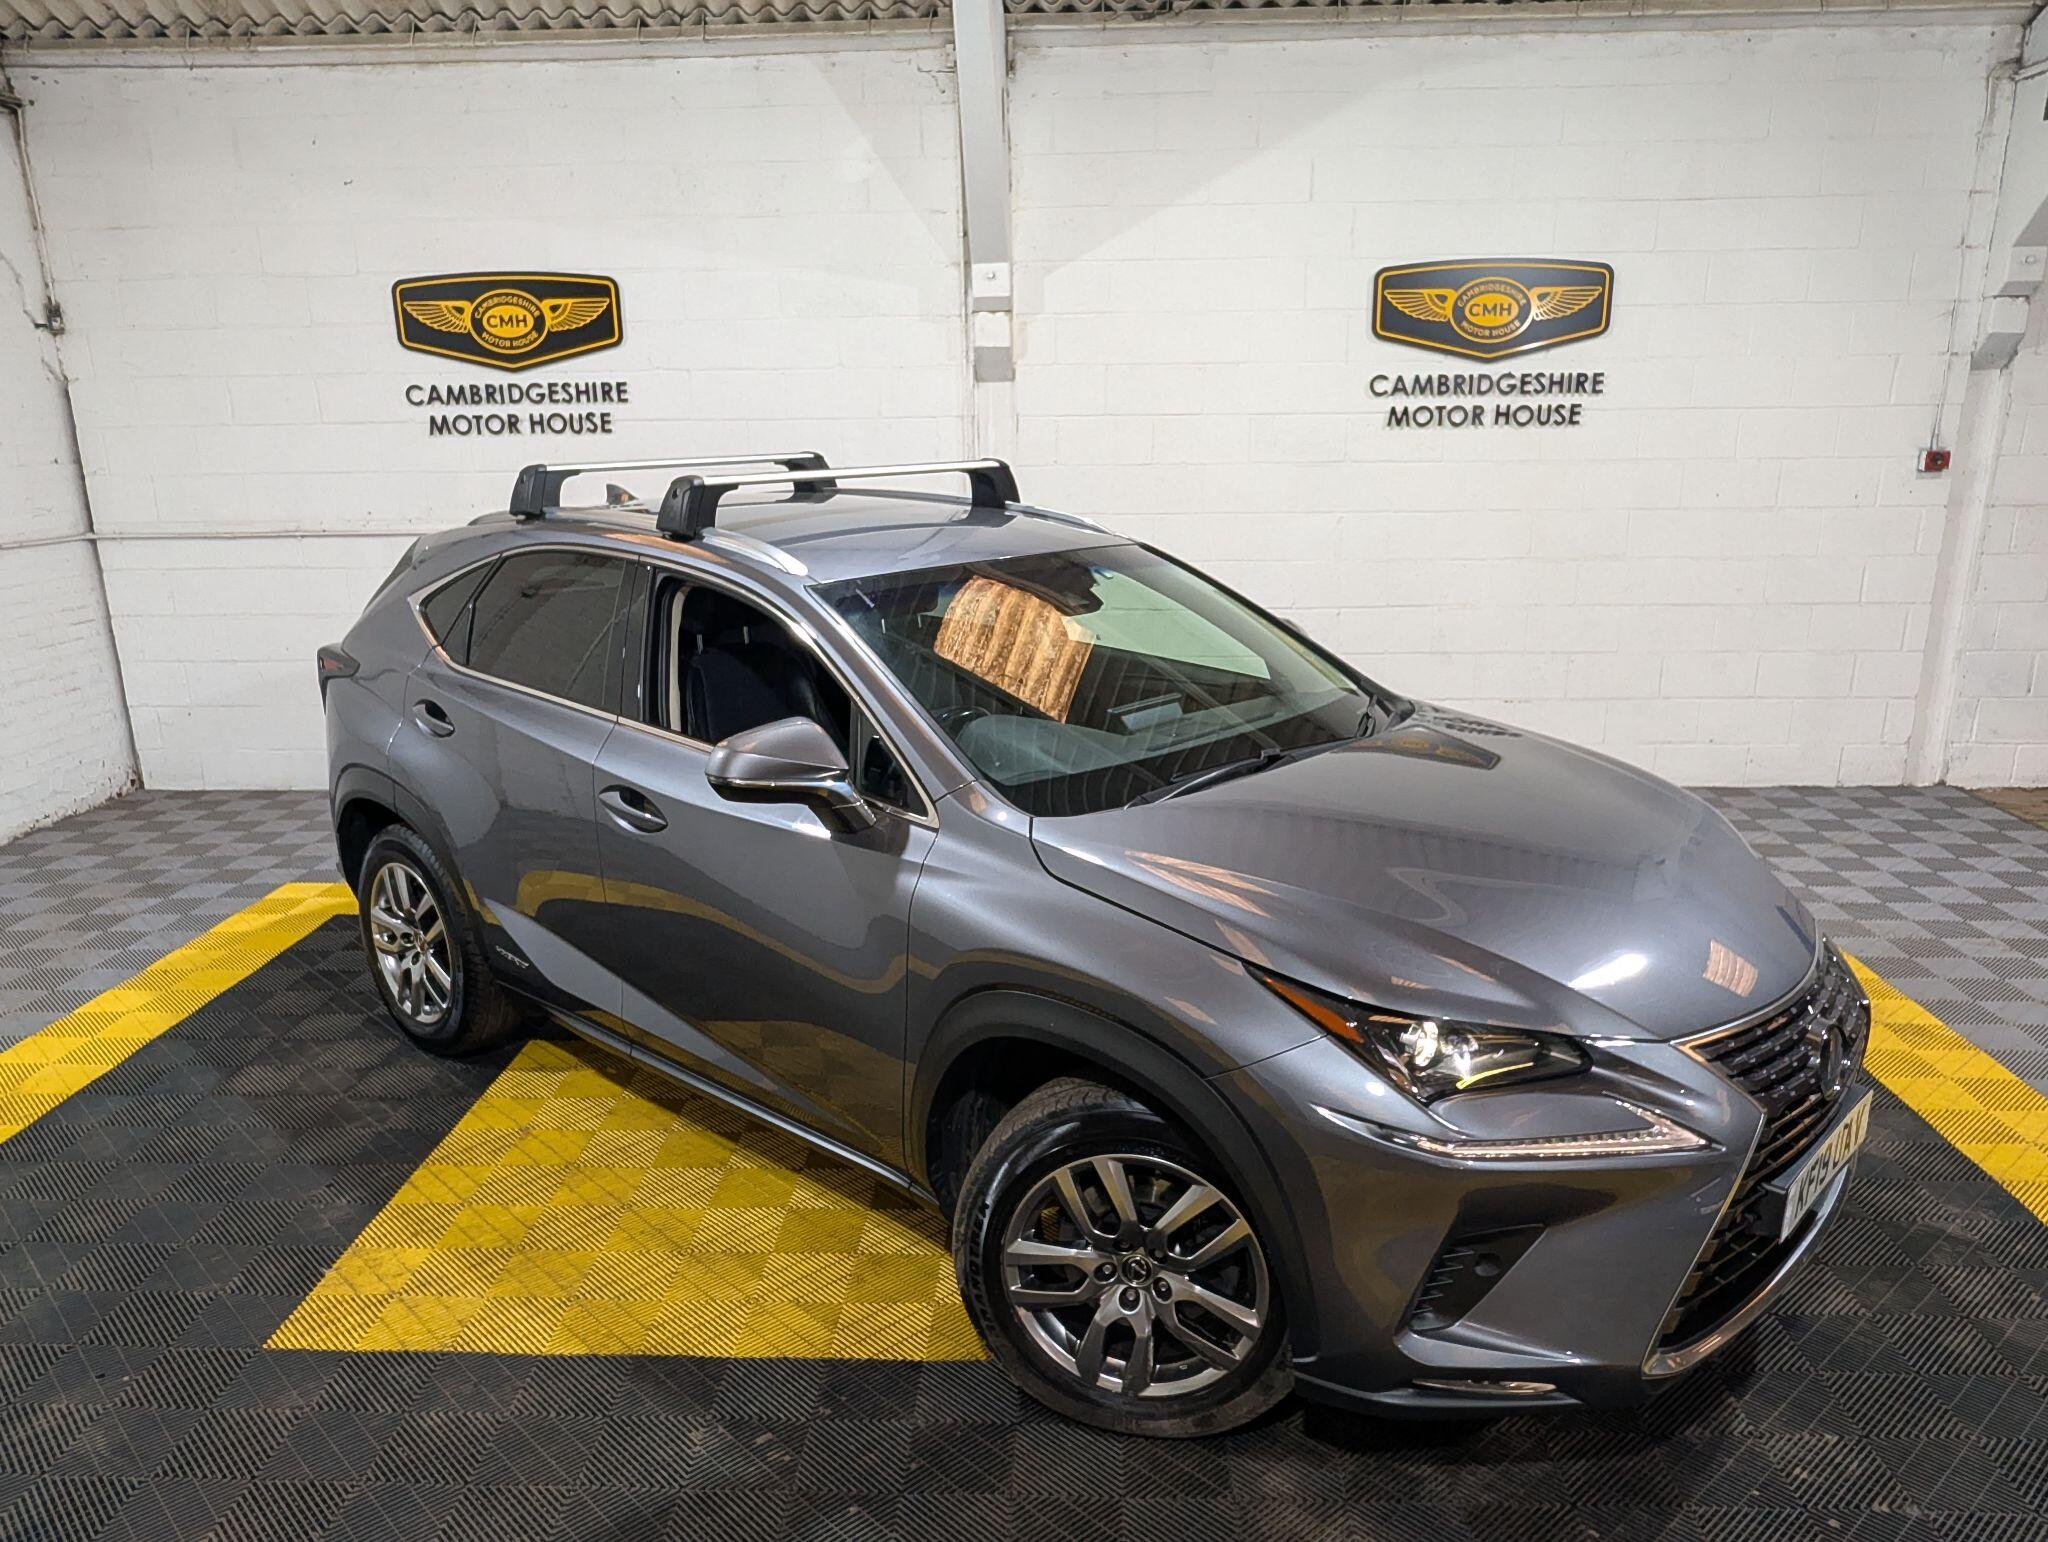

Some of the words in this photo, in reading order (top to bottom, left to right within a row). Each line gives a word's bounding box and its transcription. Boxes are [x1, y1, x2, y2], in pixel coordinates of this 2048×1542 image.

[486, 313, 528, 329] CMH
[1469, 303, 1512, 317] CMH
[482, 331, 511, 348] MOTOR
[1461, 321, 1490, 337] MOTOR
[1492, 319, 1521, 337] HOUSE
[405, 381, 629, 407] CAMBRIDGESHIRE
[1369, 371, 1606, 398] CAMBRIDGESHIRE
[429, 413, 521, 436] MOTOR
[529, 412, 614, 435] HOUSE
[1386, 405, 1484, 428] MOTOR
[1494, 403, 1583, 427] HOUSE
[1832, 1103, 1867, 1170] UAV
